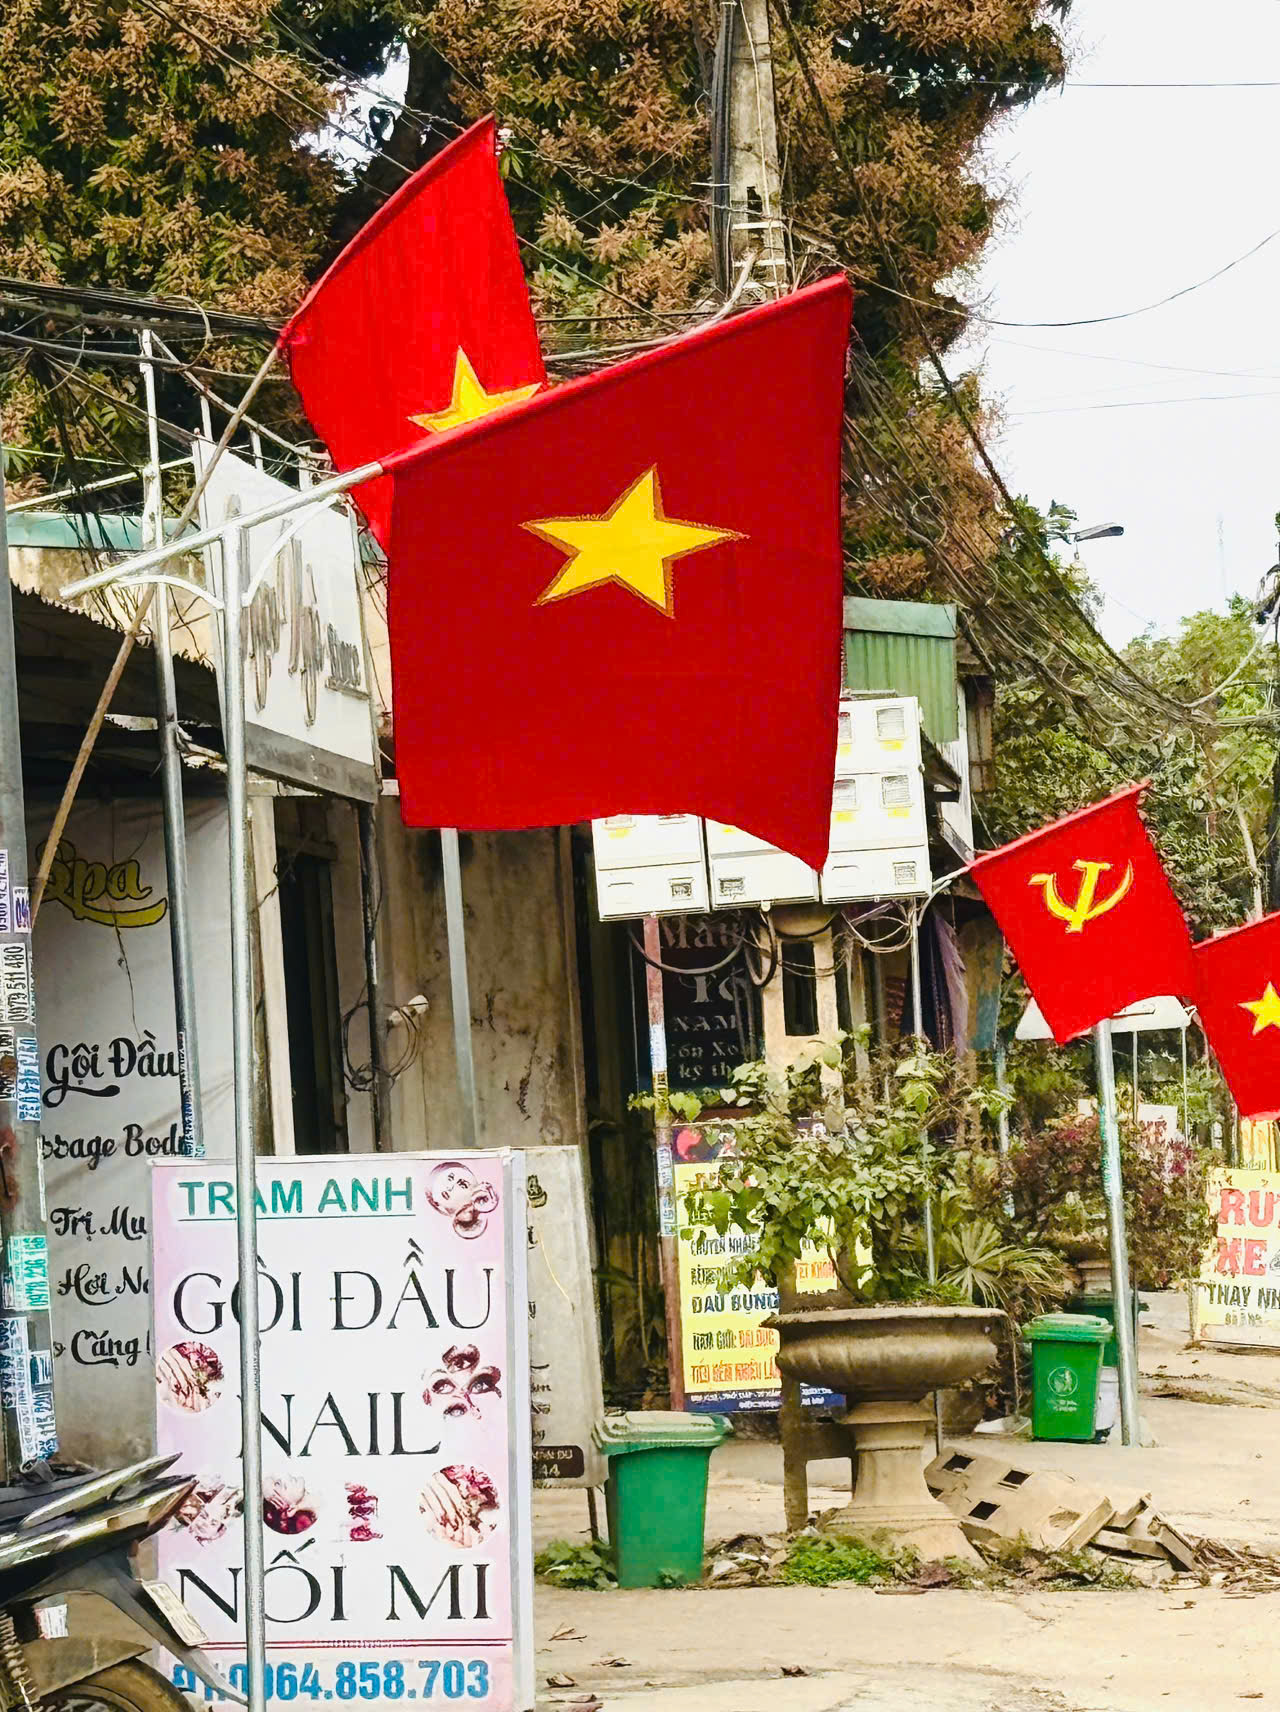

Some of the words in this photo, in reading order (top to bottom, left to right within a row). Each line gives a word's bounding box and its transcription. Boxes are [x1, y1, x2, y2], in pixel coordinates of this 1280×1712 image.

[42, 1043, 121, 1108] Gội
[108, 1029, 181, 1078] Đầu
[318, 1176, 413, 1214] ANH
[50, 1207, 97, 1242] Trị
[1216, 1236, 1267, 1277] XE
[329, 1238, 494, 1330] ĐẦU
[1207, 1283, 1251, 1307] THAY
[236, 1391, 442, 1458] NAIL
[176, 1538, 349, 1624] NỐI
[386, 1563, 492, 1621] MI
